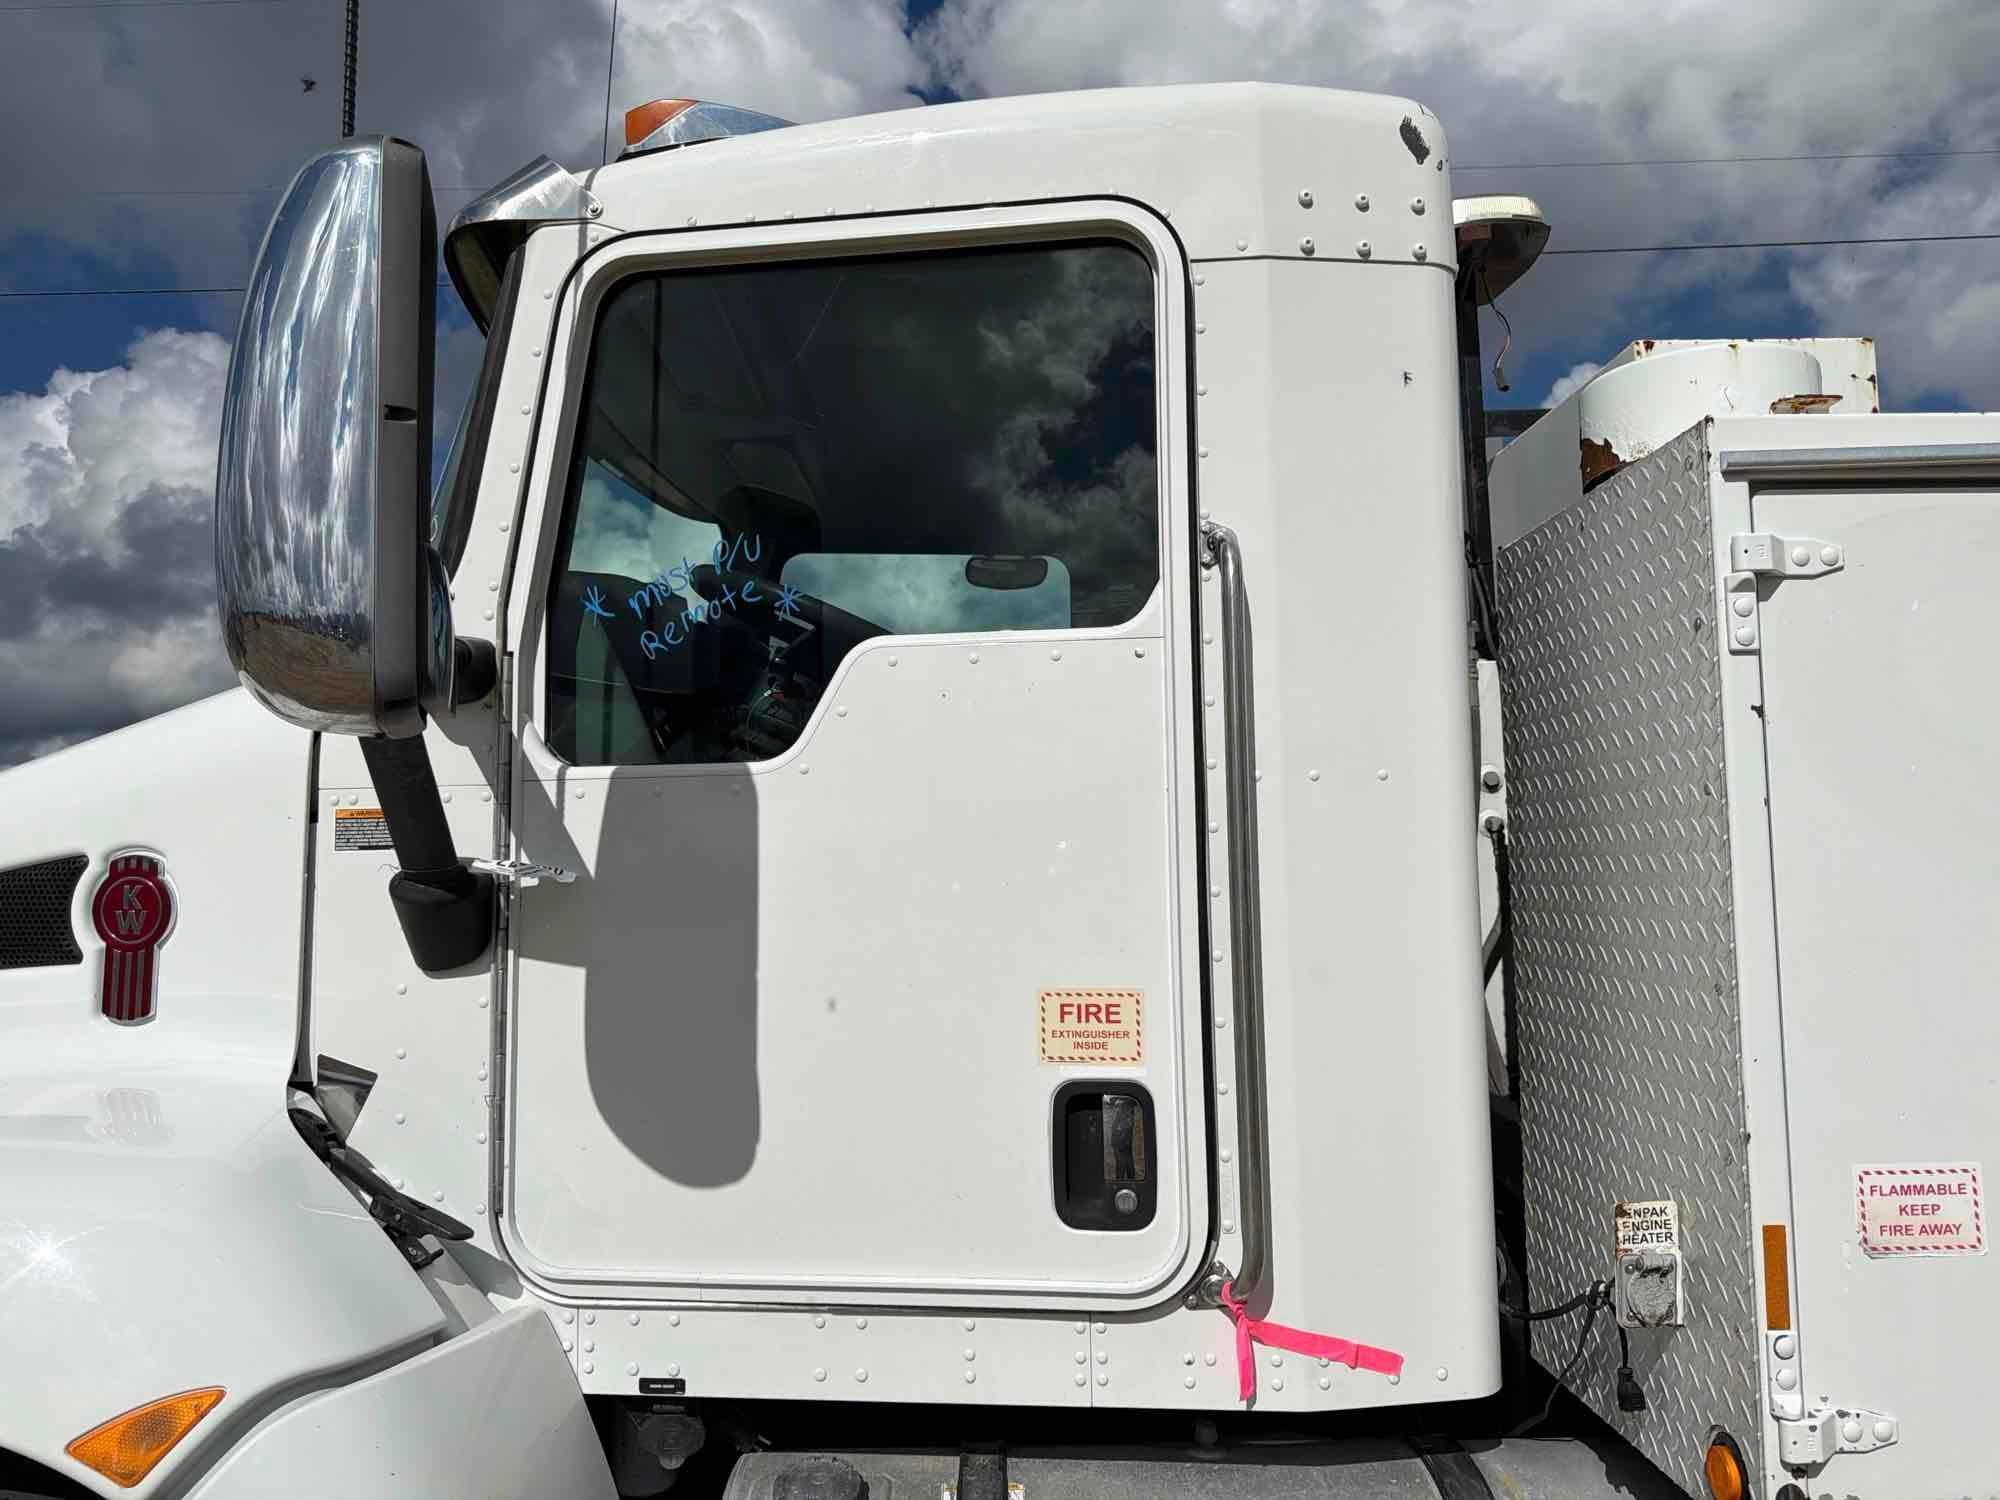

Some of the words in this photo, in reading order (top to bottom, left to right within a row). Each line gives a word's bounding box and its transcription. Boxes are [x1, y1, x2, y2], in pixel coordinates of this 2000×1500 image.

[121, 885, 144, 910] K
[115, 910, 148, 934] W
[1059, 1003, 1122, 1024] FIRE
[1051, 1030, 1130, 1039] EXTINGUISHER
[1073, 1041, 1109, 1050] INSIDE
[1869, 1183, 1968, 1196] FLAMMABLE
[1898, 1204, 1941, 1216] KEEP
[1879, 1224, 1914, 1237] FIRE
[1918, 1223, 1962, 1236] AWAY
[1622, 1231, 1674, 1245] HEATER
